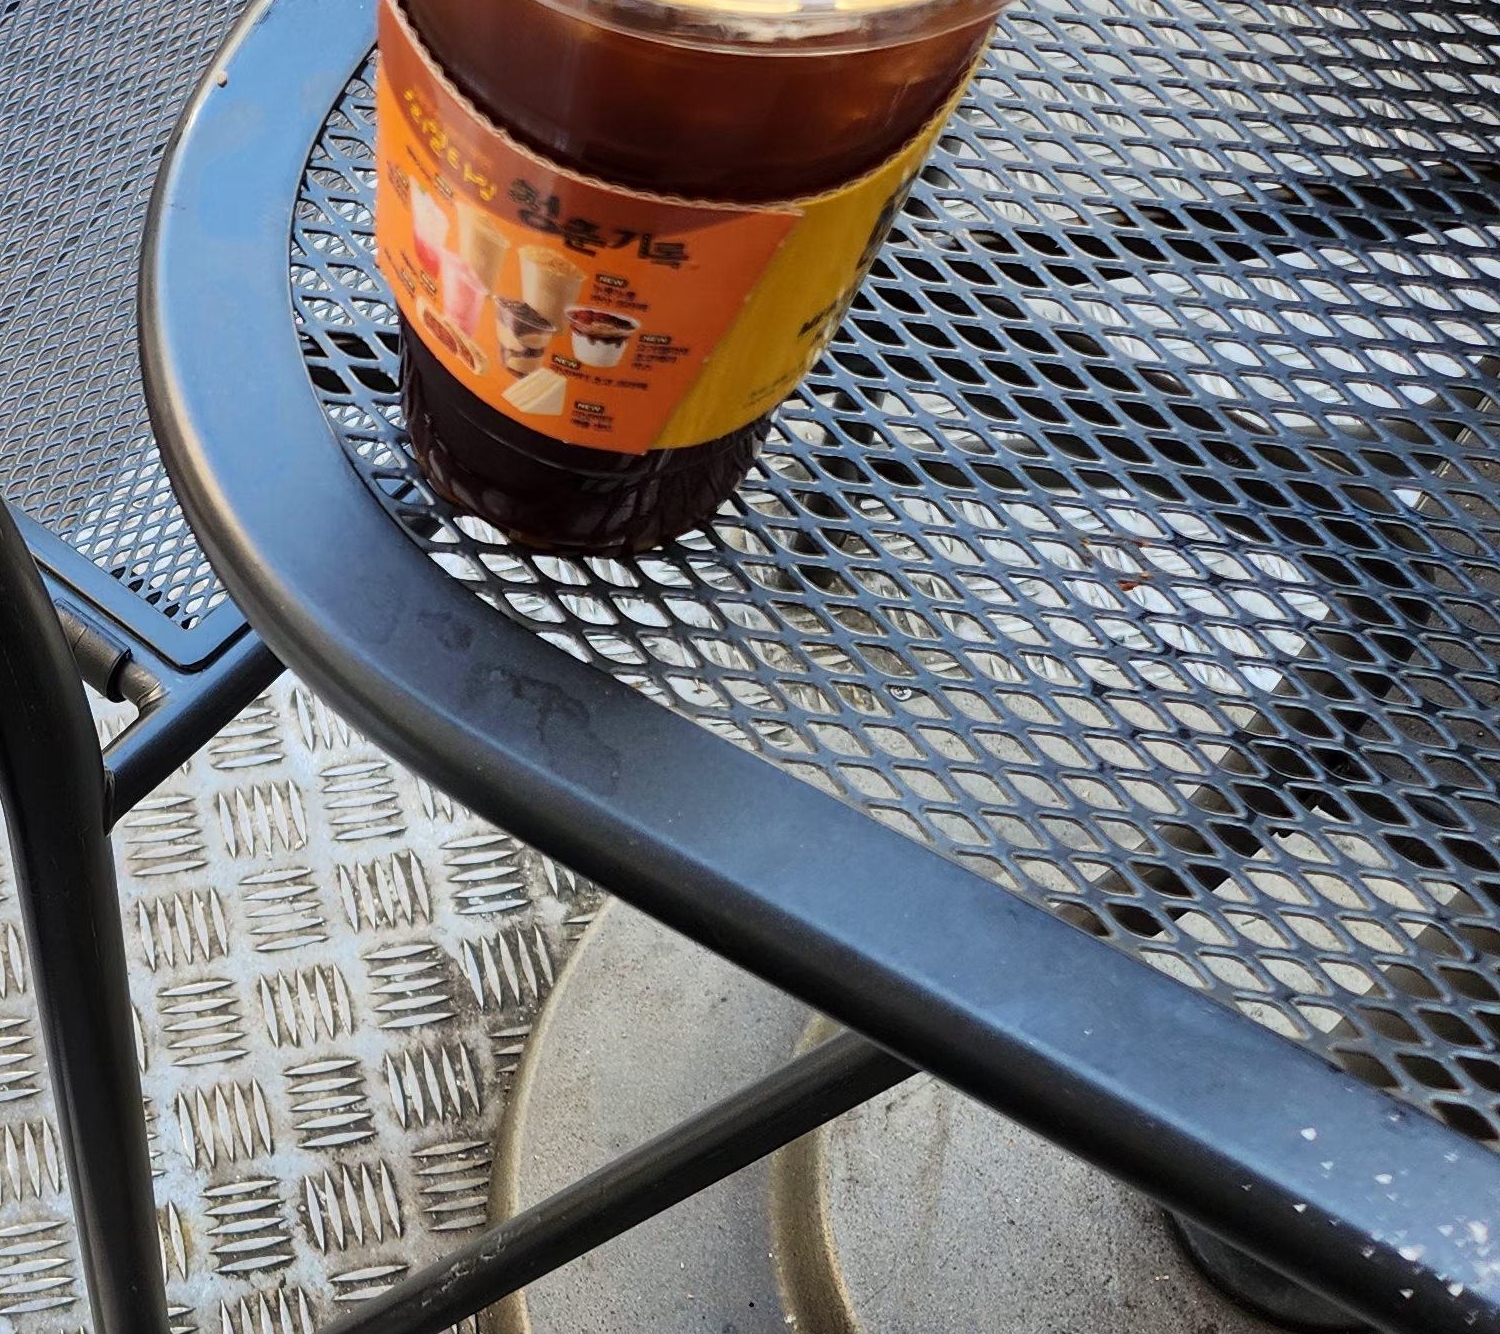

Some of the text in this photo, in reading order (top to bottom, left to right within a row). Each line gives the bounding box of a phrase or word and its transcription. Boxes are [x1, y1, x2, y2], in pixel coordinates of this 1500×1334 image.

[598, 275, 625, 287] NEW
[642, 335, 668, 344] NEW
[554, 356, 578, 368] NEW
[577, 403, 601, 412] NEW
